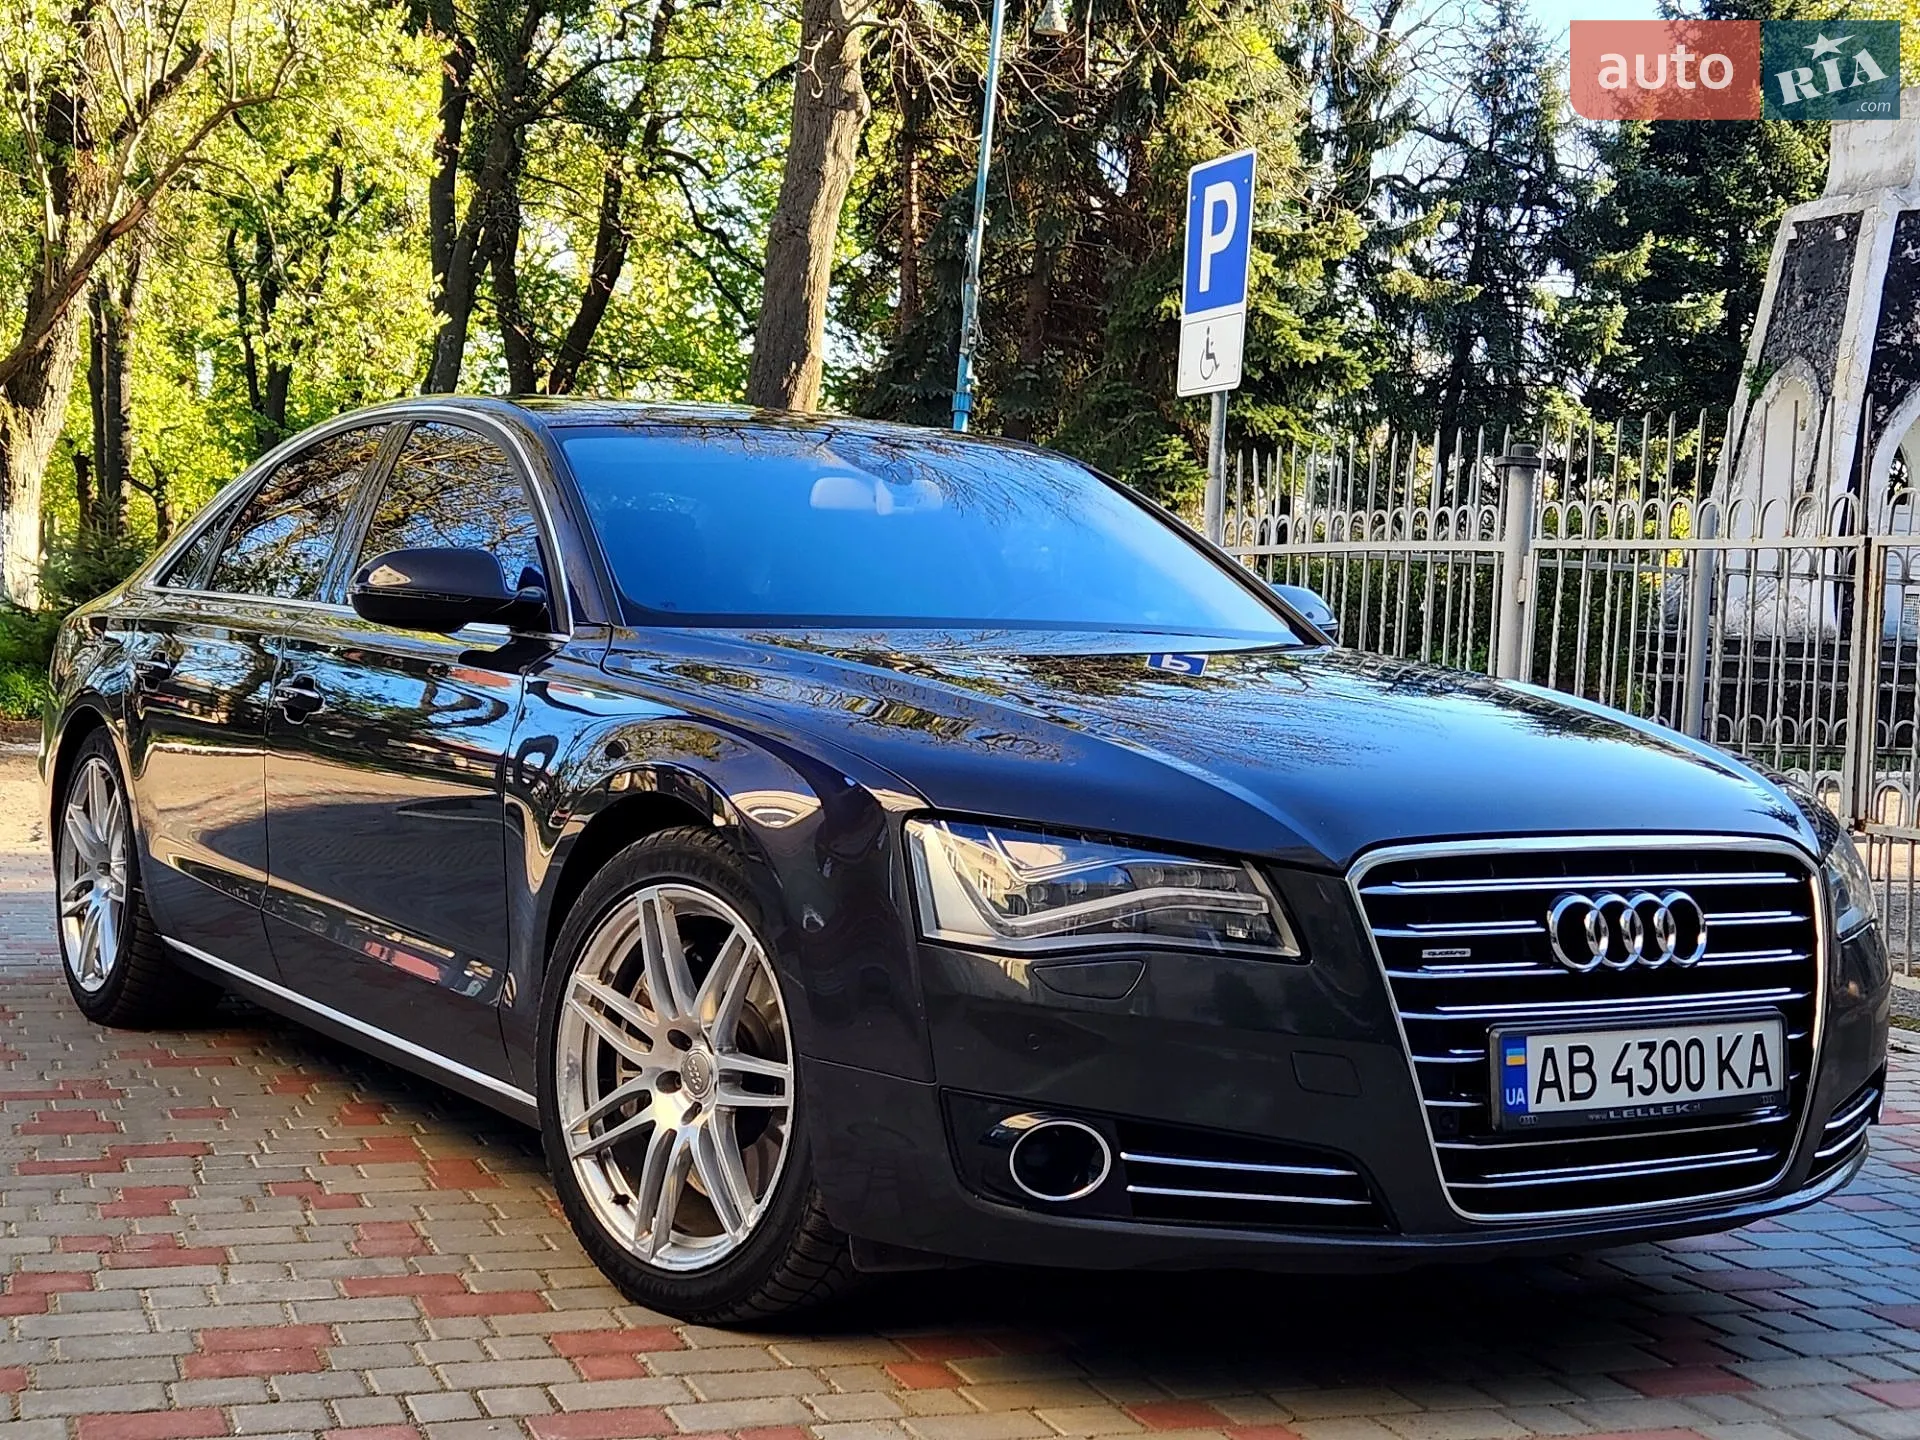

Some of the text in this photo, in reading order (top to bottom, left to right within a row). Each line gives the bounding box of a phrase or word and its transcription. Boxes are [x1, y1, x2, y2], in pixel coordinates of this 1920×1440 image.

[1199, 181, 1237, 293] P
[1505, 1087, 1526, 1105] UA
[1535, 1032, 1773, 1104] AB 4300 KA
